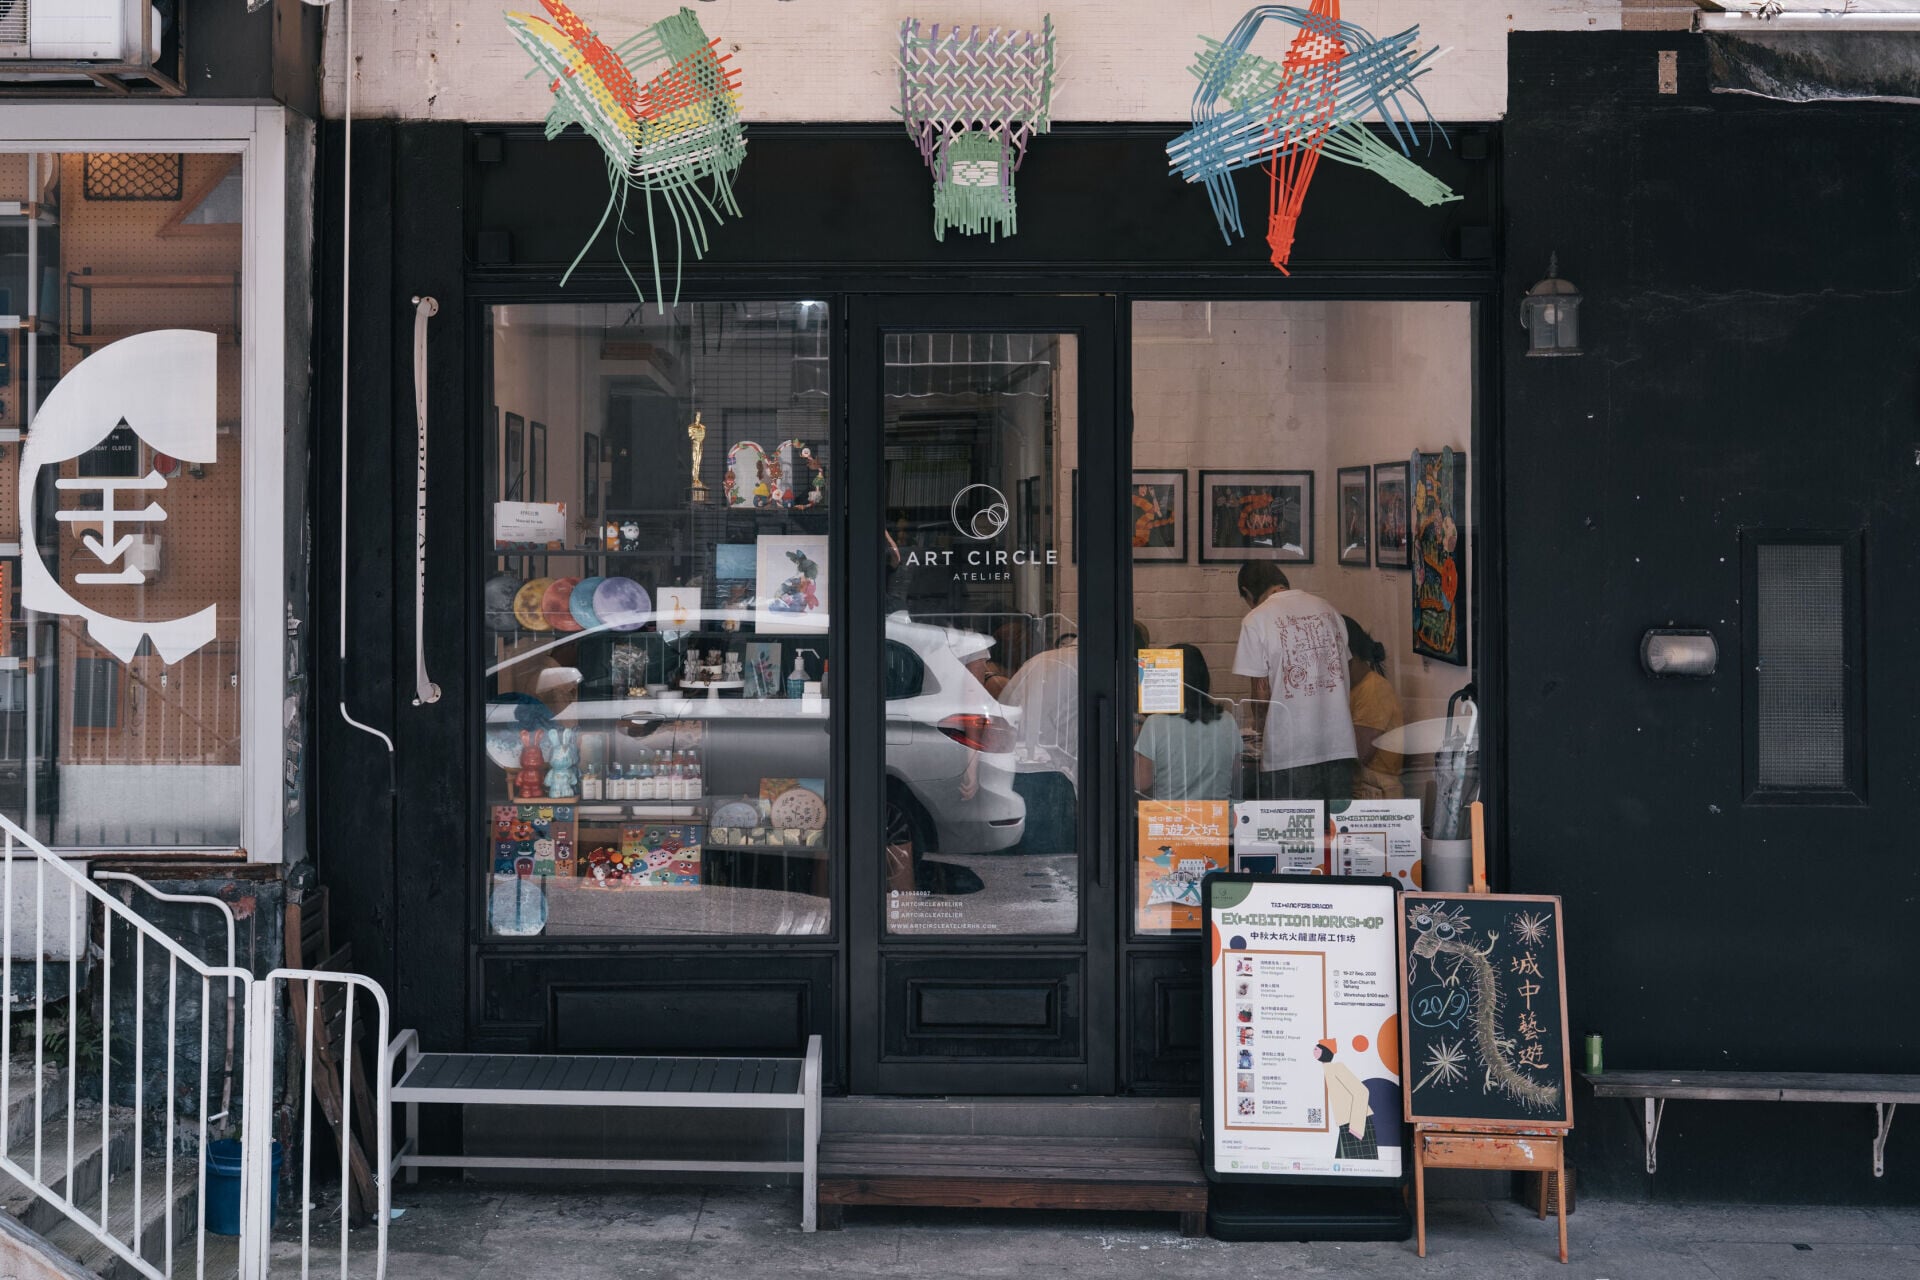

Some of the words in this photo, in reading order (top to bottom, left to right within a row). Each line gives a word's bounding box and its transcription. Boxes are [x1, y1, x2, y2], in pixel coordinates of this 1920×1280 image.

[905, 551, 953, 566] ART
[967, 550, 1058, 566] CIRCLE
[953, 572, 1011, 581] ATELIER
[1288, 814, 1315, 828] ART
[1336, 814, 1379, 822] EXHIBITION
[1148, 823, 1220, 836] 重遊大坑
[1257, 828, 1315, 841] EXHIBI
[1278, 841, 1315, 854] TION
[1221, 913, 1311, 927] EXHIBITION
[1312, 915, 1384, 929] WORKSHOP
[1250, 931, 1356, 943] 中秋大坑火龍畫展工作坊
[1418, 989, 1467, 1020] 20/9
[1510, 951, 1549, 1069] 城中藝遊
